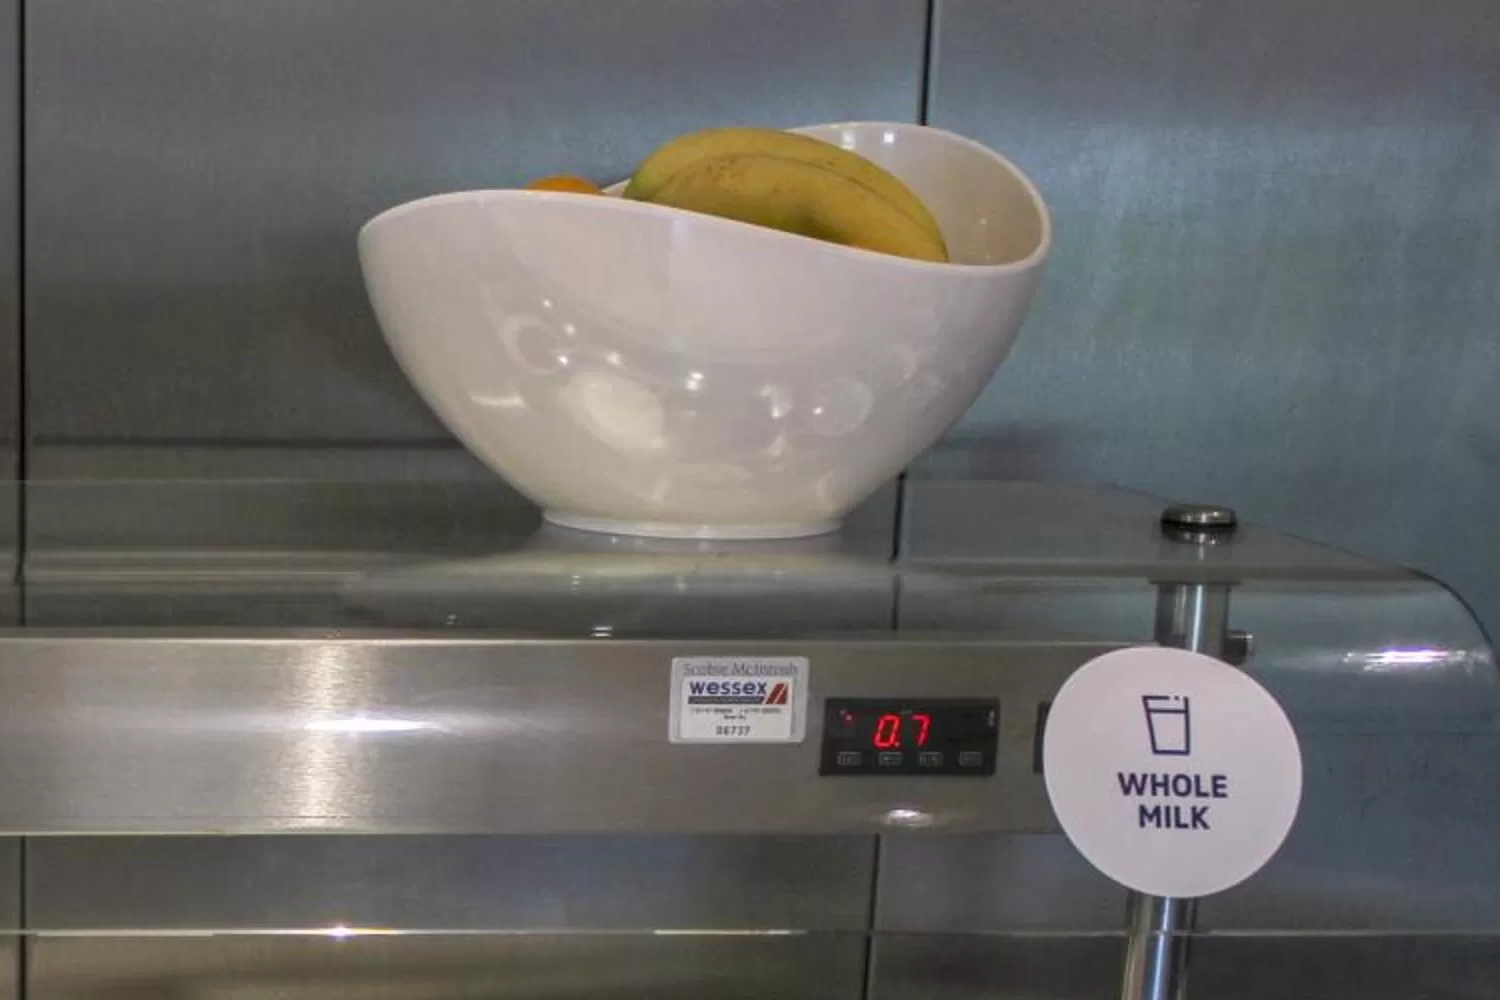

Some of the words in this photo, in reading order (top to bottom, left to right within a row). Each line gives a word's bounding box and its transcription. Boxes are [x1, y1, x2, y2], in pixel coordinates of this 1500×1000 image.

[690, 680, 767, 695] wessex
[1118, 772, 1228, 798] WHOLE
[1139, 805, 1211, 830] MILK
